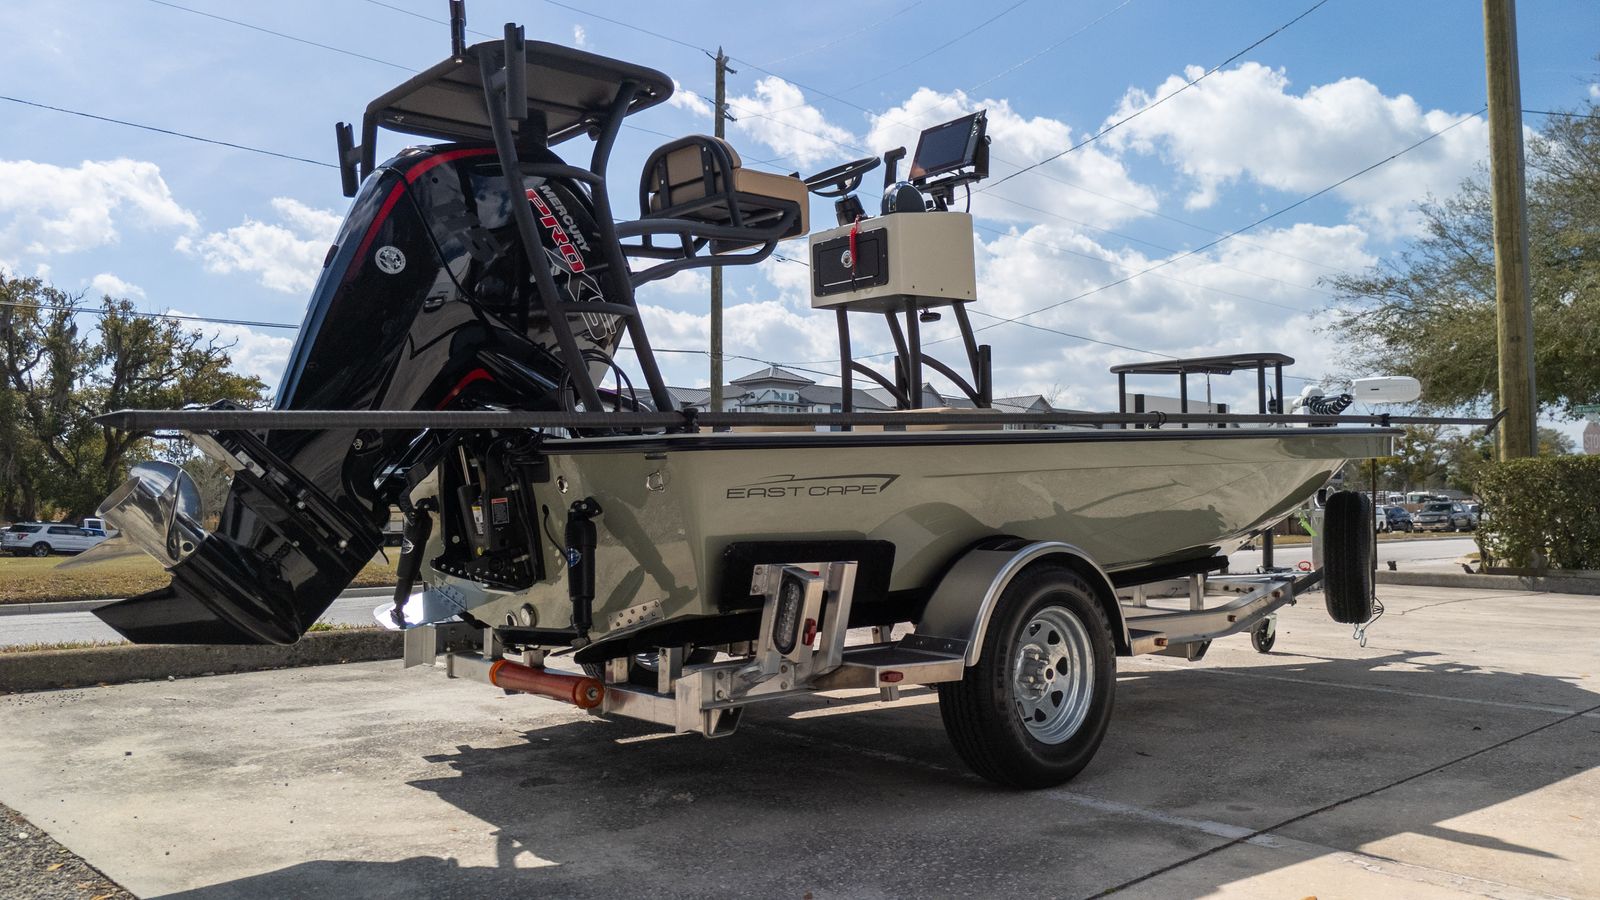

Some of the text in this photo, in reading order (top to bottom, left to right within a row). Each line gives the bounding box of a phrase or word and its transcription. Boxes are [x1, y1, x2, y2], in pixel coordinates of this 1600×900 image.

[525, 188, 586, 273] PRO
[539, 185, 591, 252] MERCURY
[1584, 434, 1600, 449] STO
[726, 485, 878, 499] EAST CAPE
